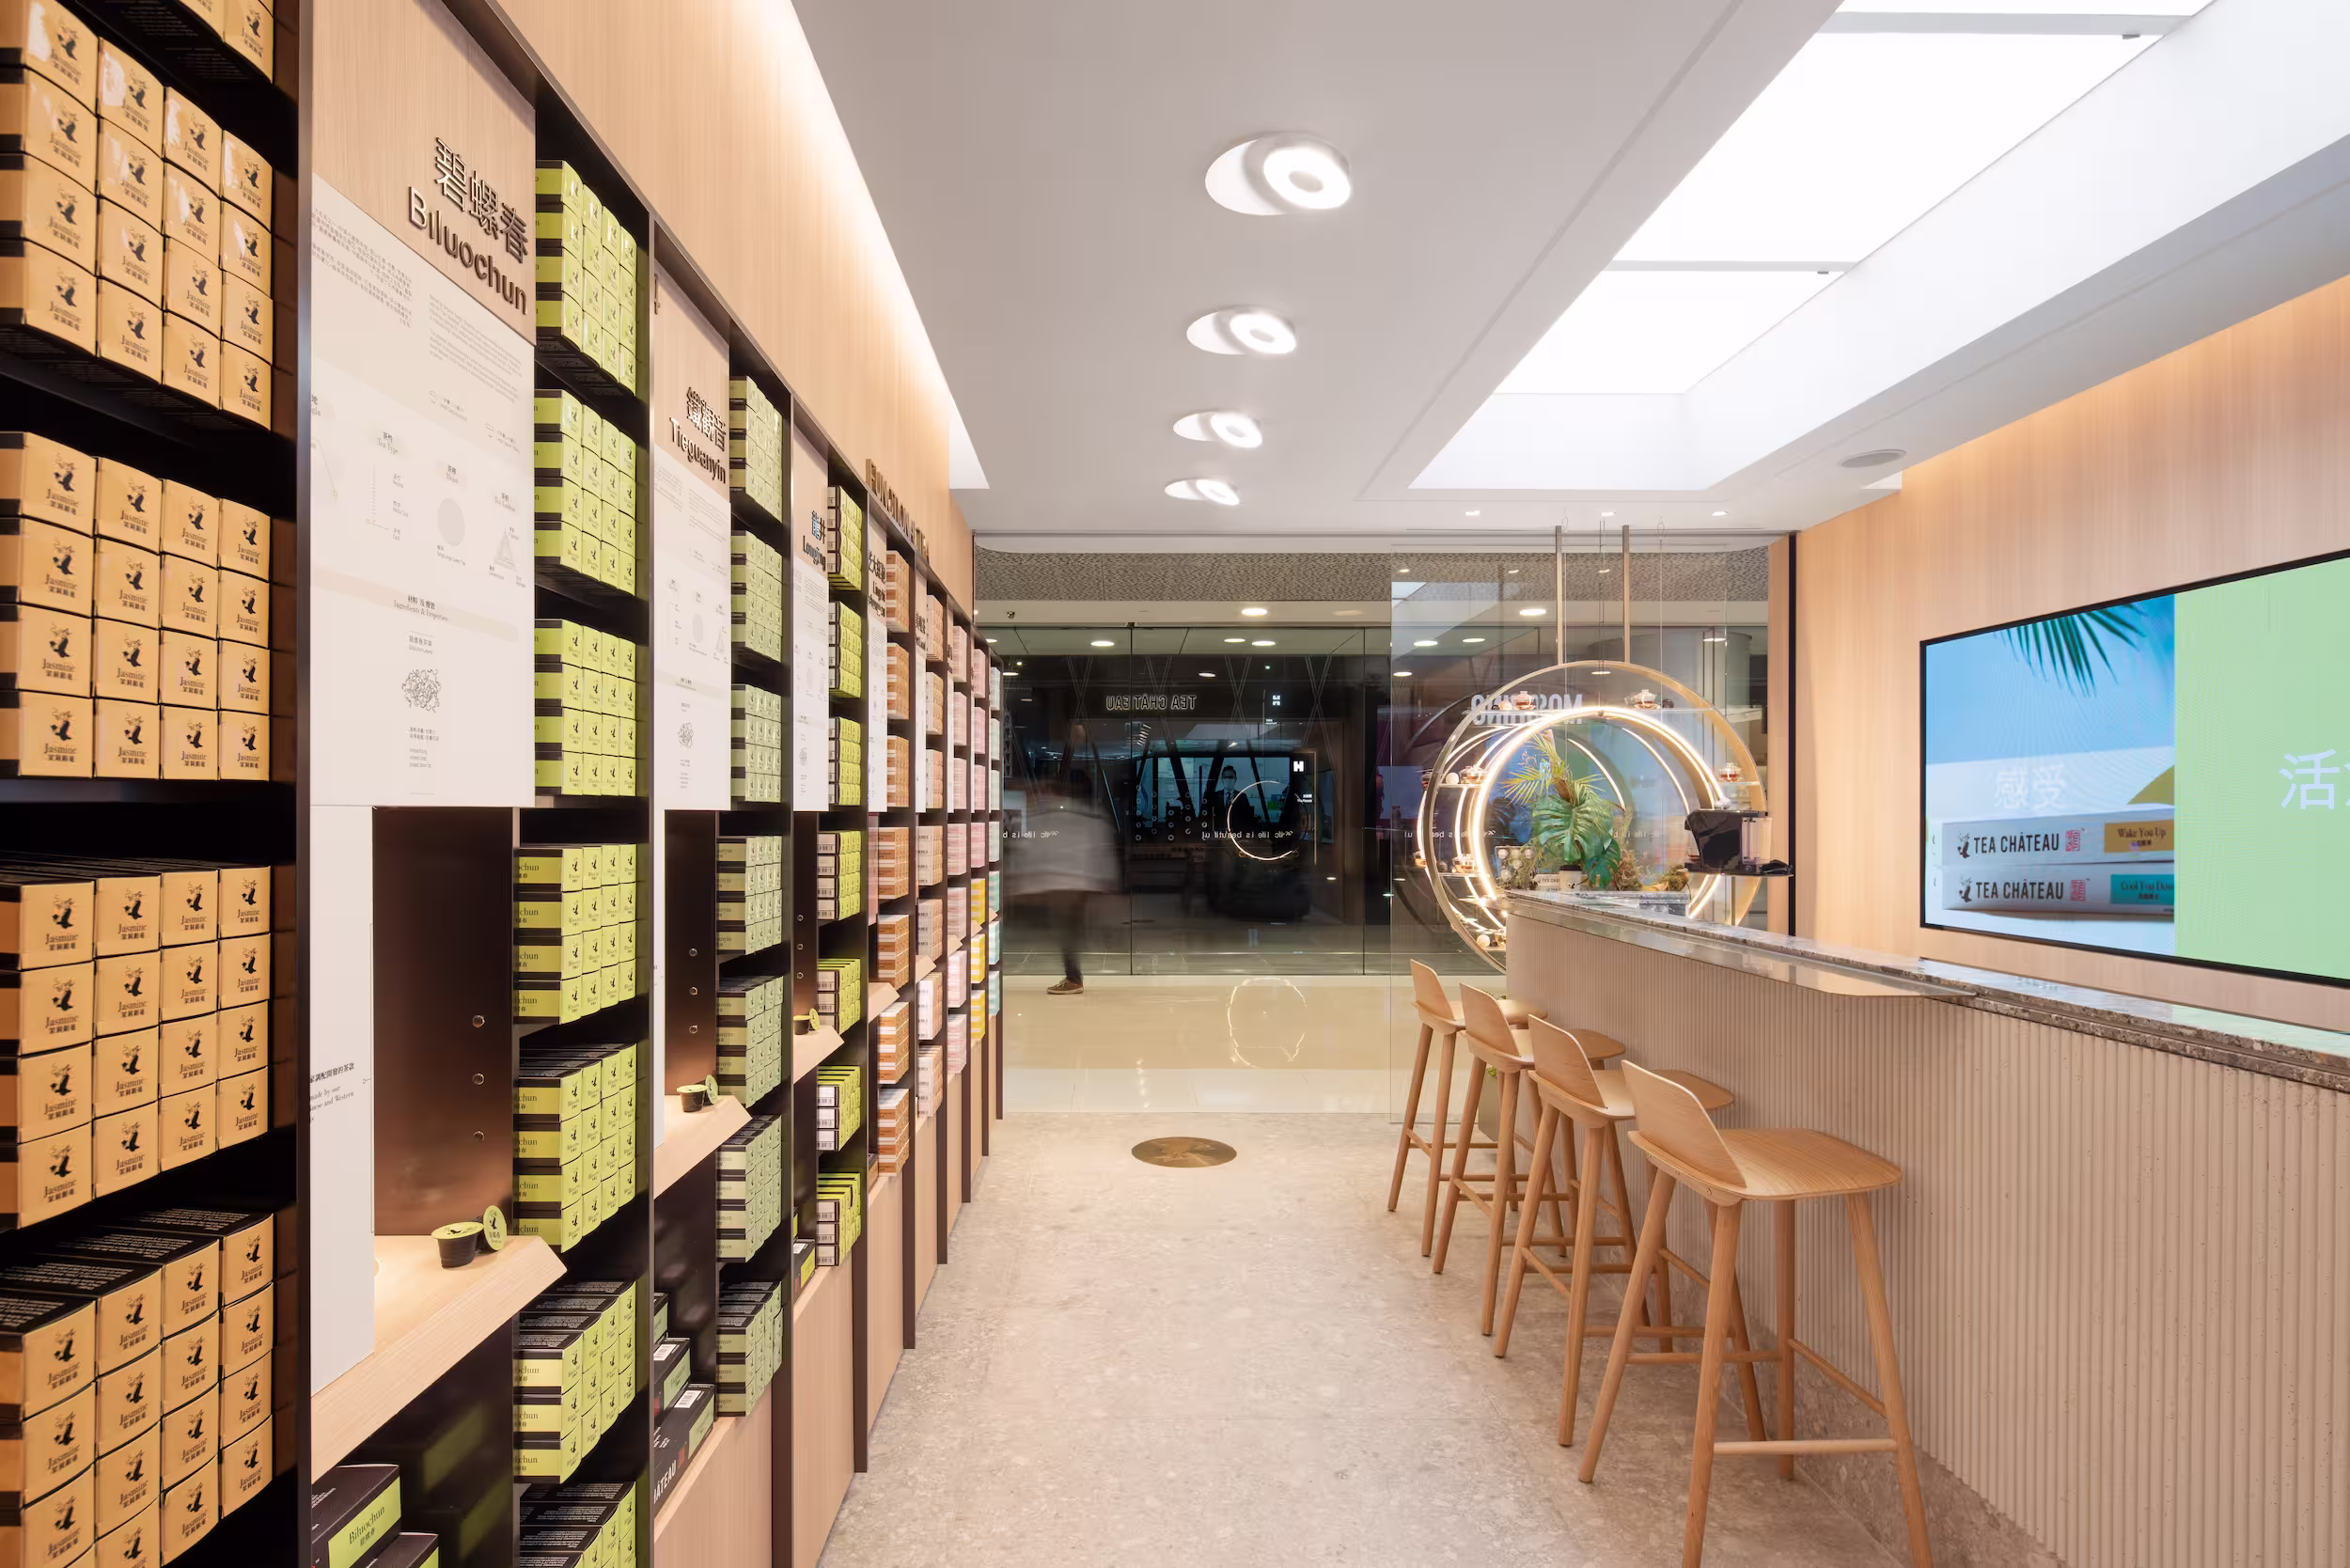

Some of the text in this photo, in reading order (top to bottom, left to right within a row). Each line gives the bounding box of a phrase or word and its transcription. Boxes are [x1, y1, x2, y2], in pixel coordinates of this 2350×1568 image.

[434, 137, 528, 264] 碧螺春
[408, 186, 528, 315] Biluochun
[669, 417, 727, 484] Tieguanyin
[1995, 762, 2066, 809] 感受
[2279, 748, 2350, 810] 活
[1974, 837, 1997, 854] TEA
[2000, 832, 2060, 853] CHÂTEAU
[1976, 881, 1998, 900] TEA
[2003, 878, 2064, 900] CHÂTEAU
[654, 1460, 677, 1504] ÂTEAU
[349, 1506, 385, 1545] Biluochun
